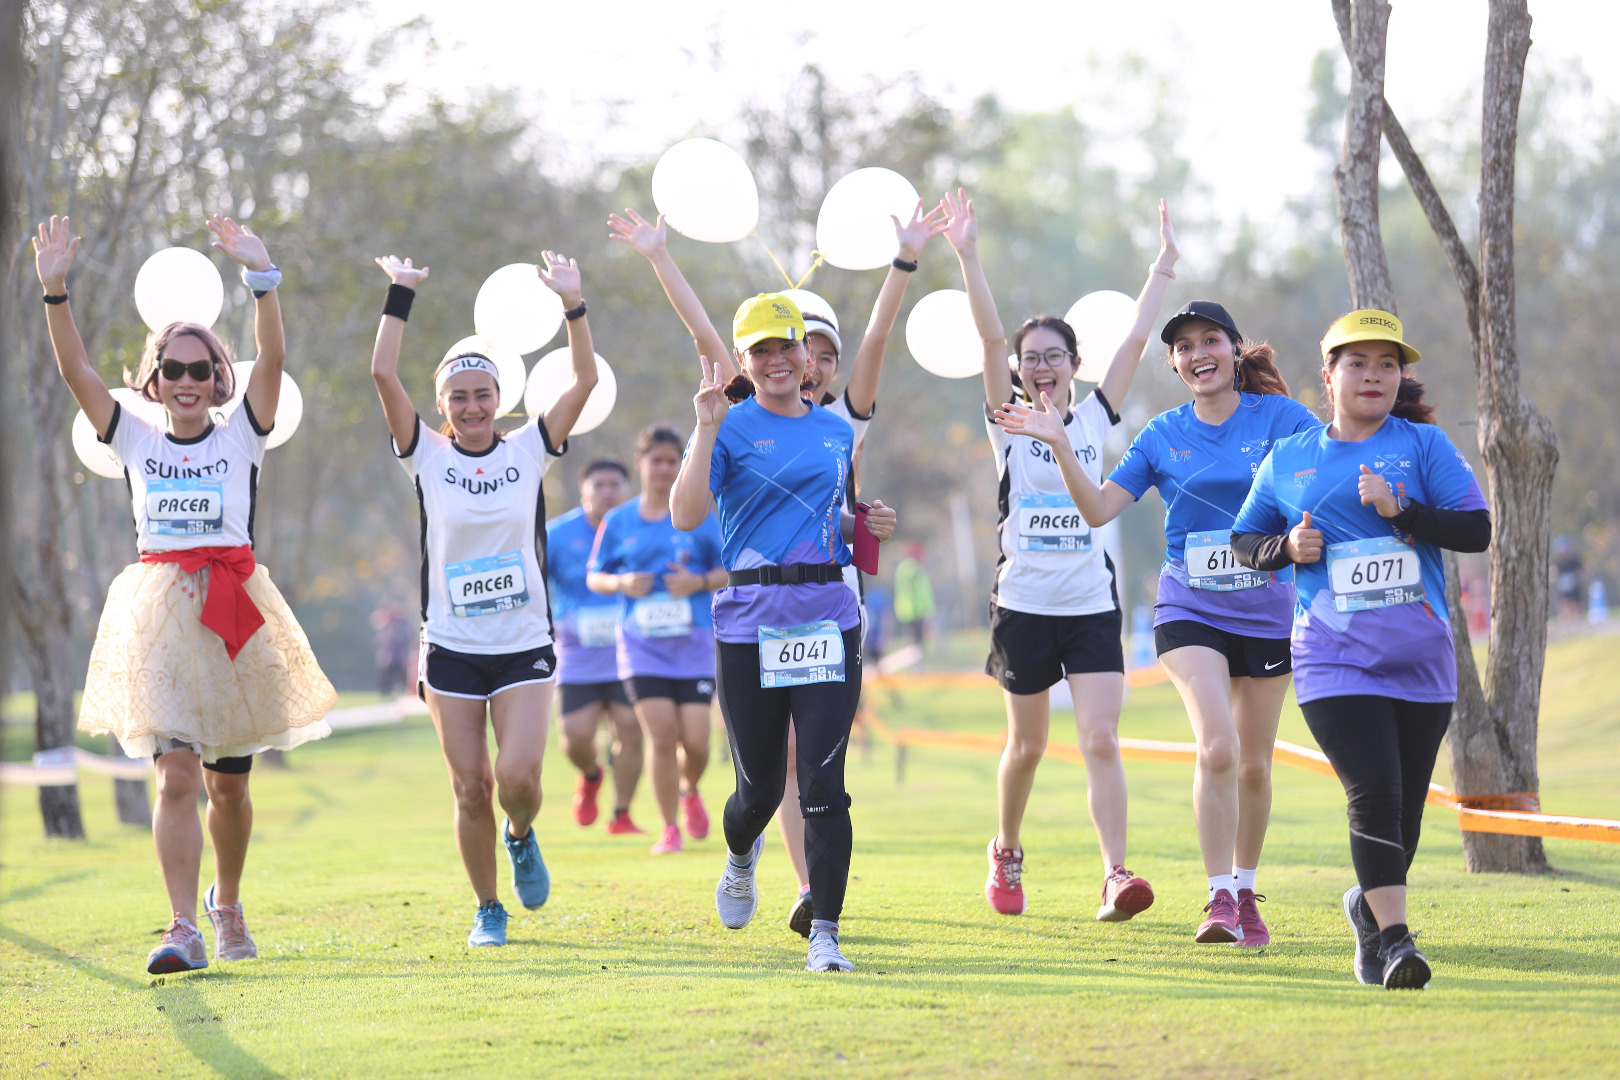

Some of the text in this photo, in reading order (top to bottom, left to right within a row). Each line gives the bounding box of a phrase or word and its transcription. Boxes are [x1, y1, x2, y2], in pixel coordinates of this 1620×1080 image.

[1359, 317, 1397, 332] SEIKO
[450, 359, 487, 373] FILA
[145, 458, 228, 479] SUUNTO
[1374, 460, 1411, 469] SP XC
[158, 498, 210, 513] PACER
[1029, 514, 1080, 529] PACER
[821, 528, 829, 548] RUN
[1207, 549, 1246, 571] 611
[1351, 557, 1404, 586] 6071
[463, 574, 514, 597] PACER
[779, 639, 829, 664] 6041
